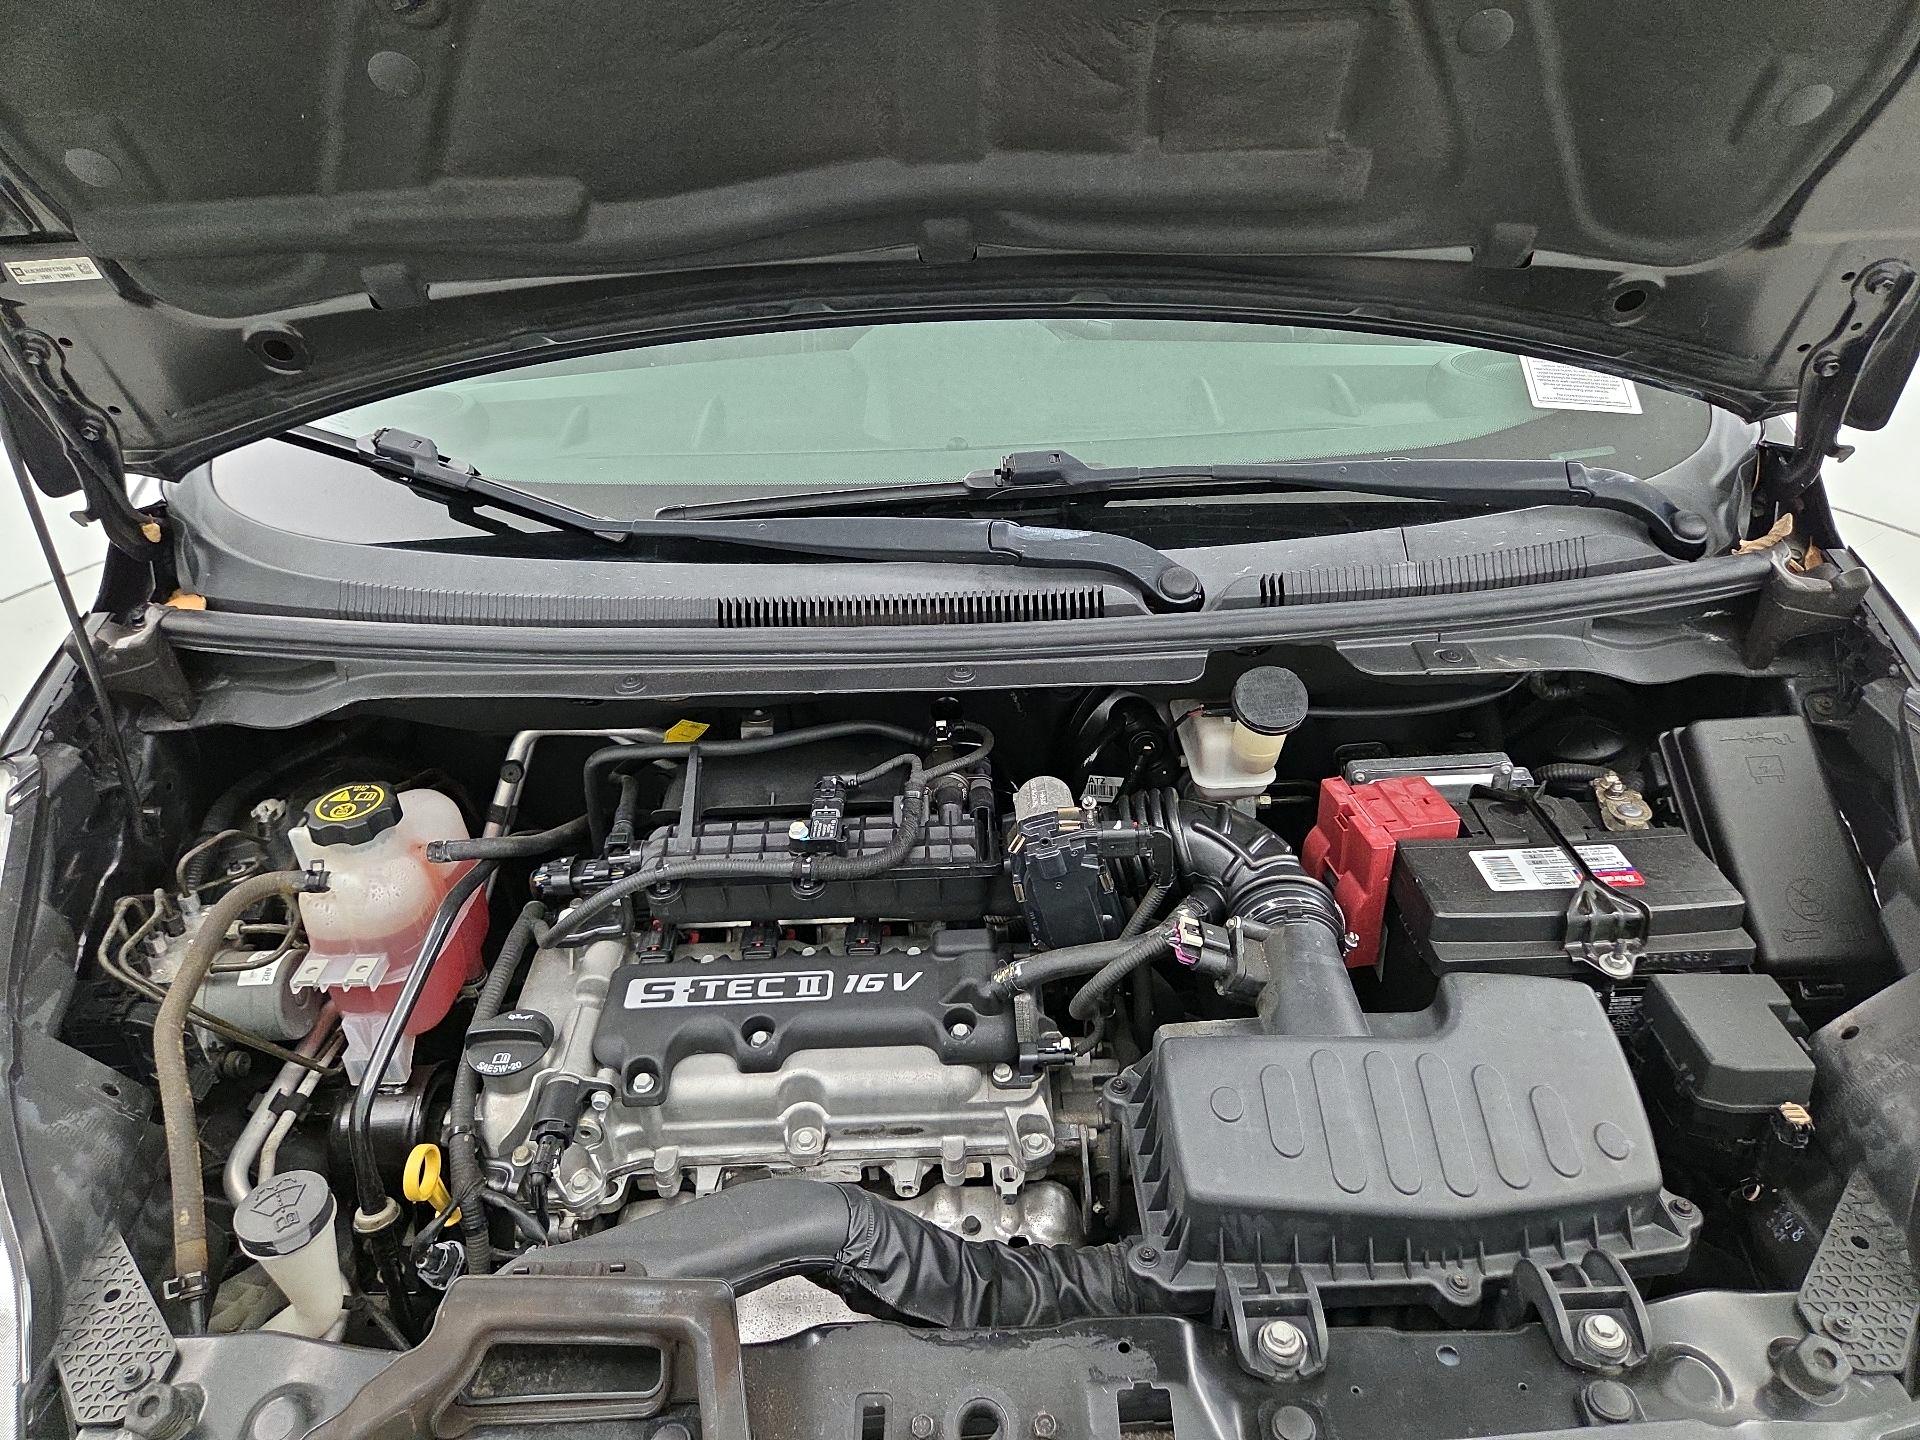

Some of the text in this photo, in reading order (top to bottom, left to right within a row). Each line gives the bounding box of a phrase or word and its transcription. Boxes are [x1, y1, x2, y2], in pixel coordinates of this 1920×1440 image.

[1088, 777, 1106, 785] ATZ
[640, 977, 786, 1004] S-TEC
[843, 971, 924, 994] 16V
